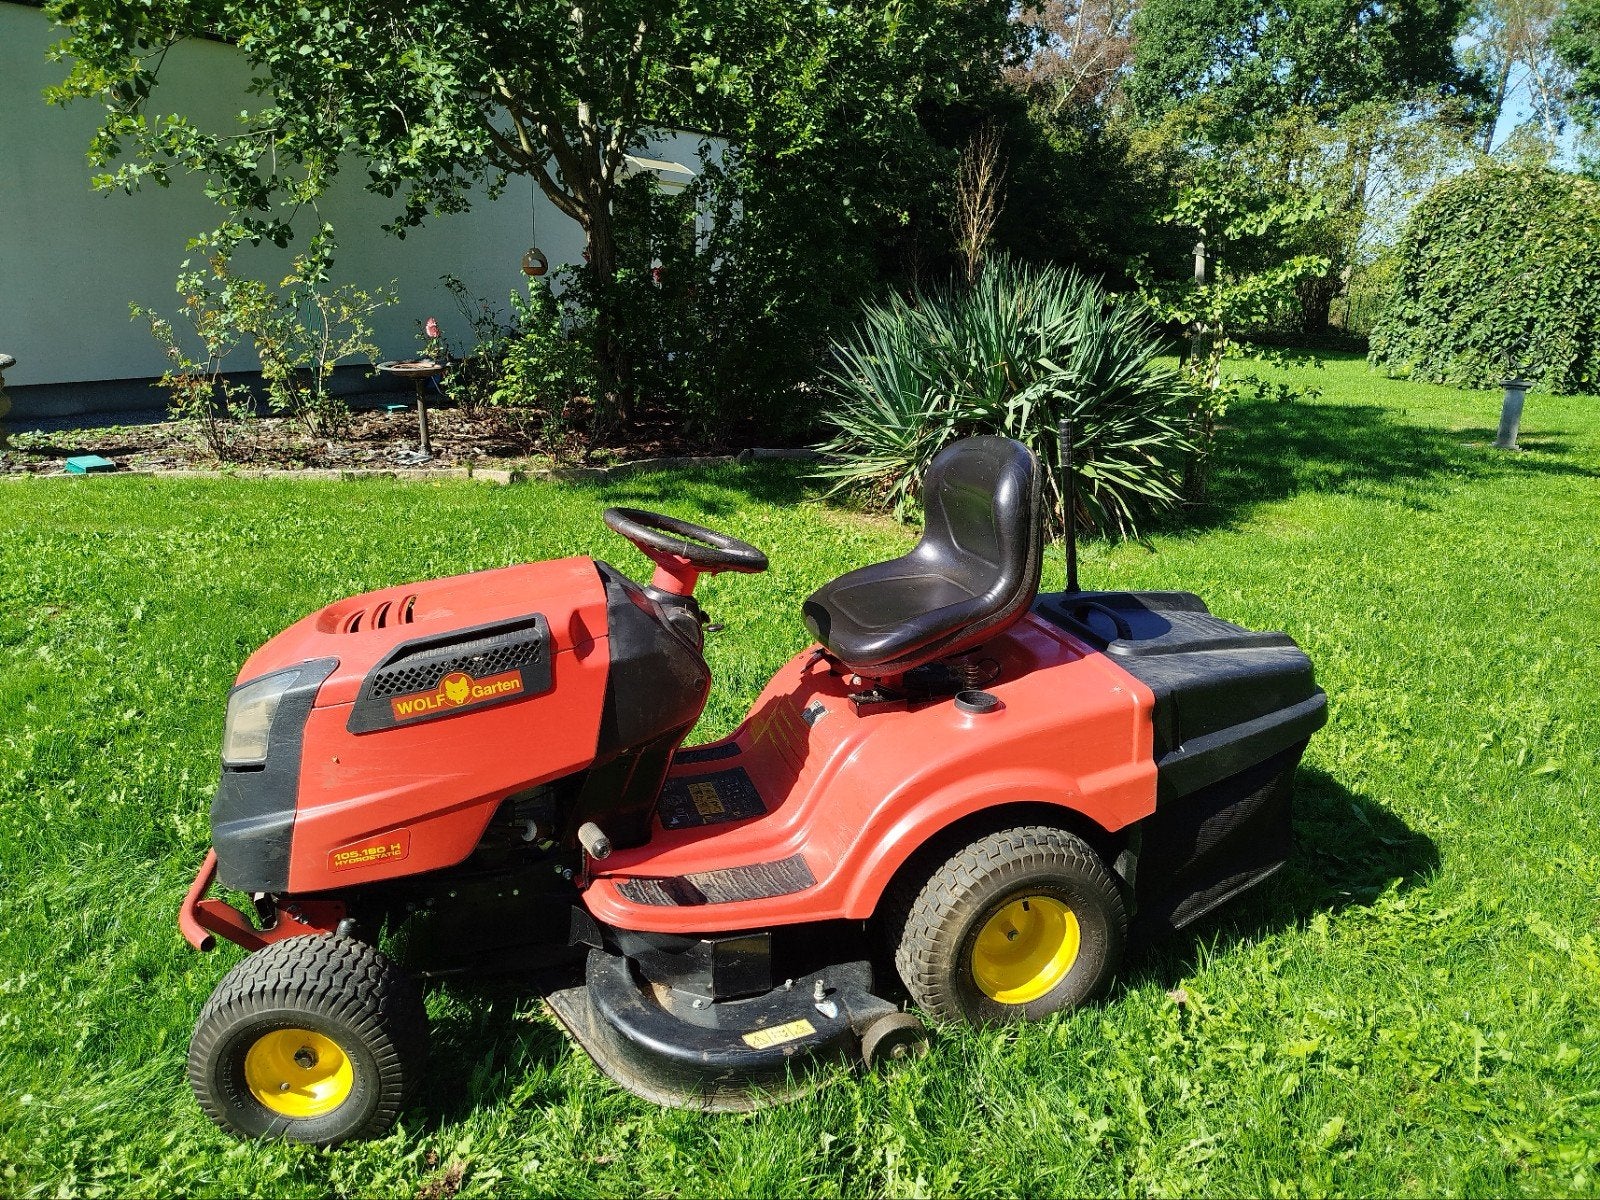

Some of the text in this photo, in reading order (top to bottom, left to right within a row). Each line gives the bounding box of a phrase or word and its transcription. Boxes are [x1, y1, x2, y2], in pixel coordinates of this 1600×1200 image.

[396, 678, 520, 715] WOLF Garten
[390, 843, 401, 851] H
[335, 849, 401, 866] HYDROSTATIC
